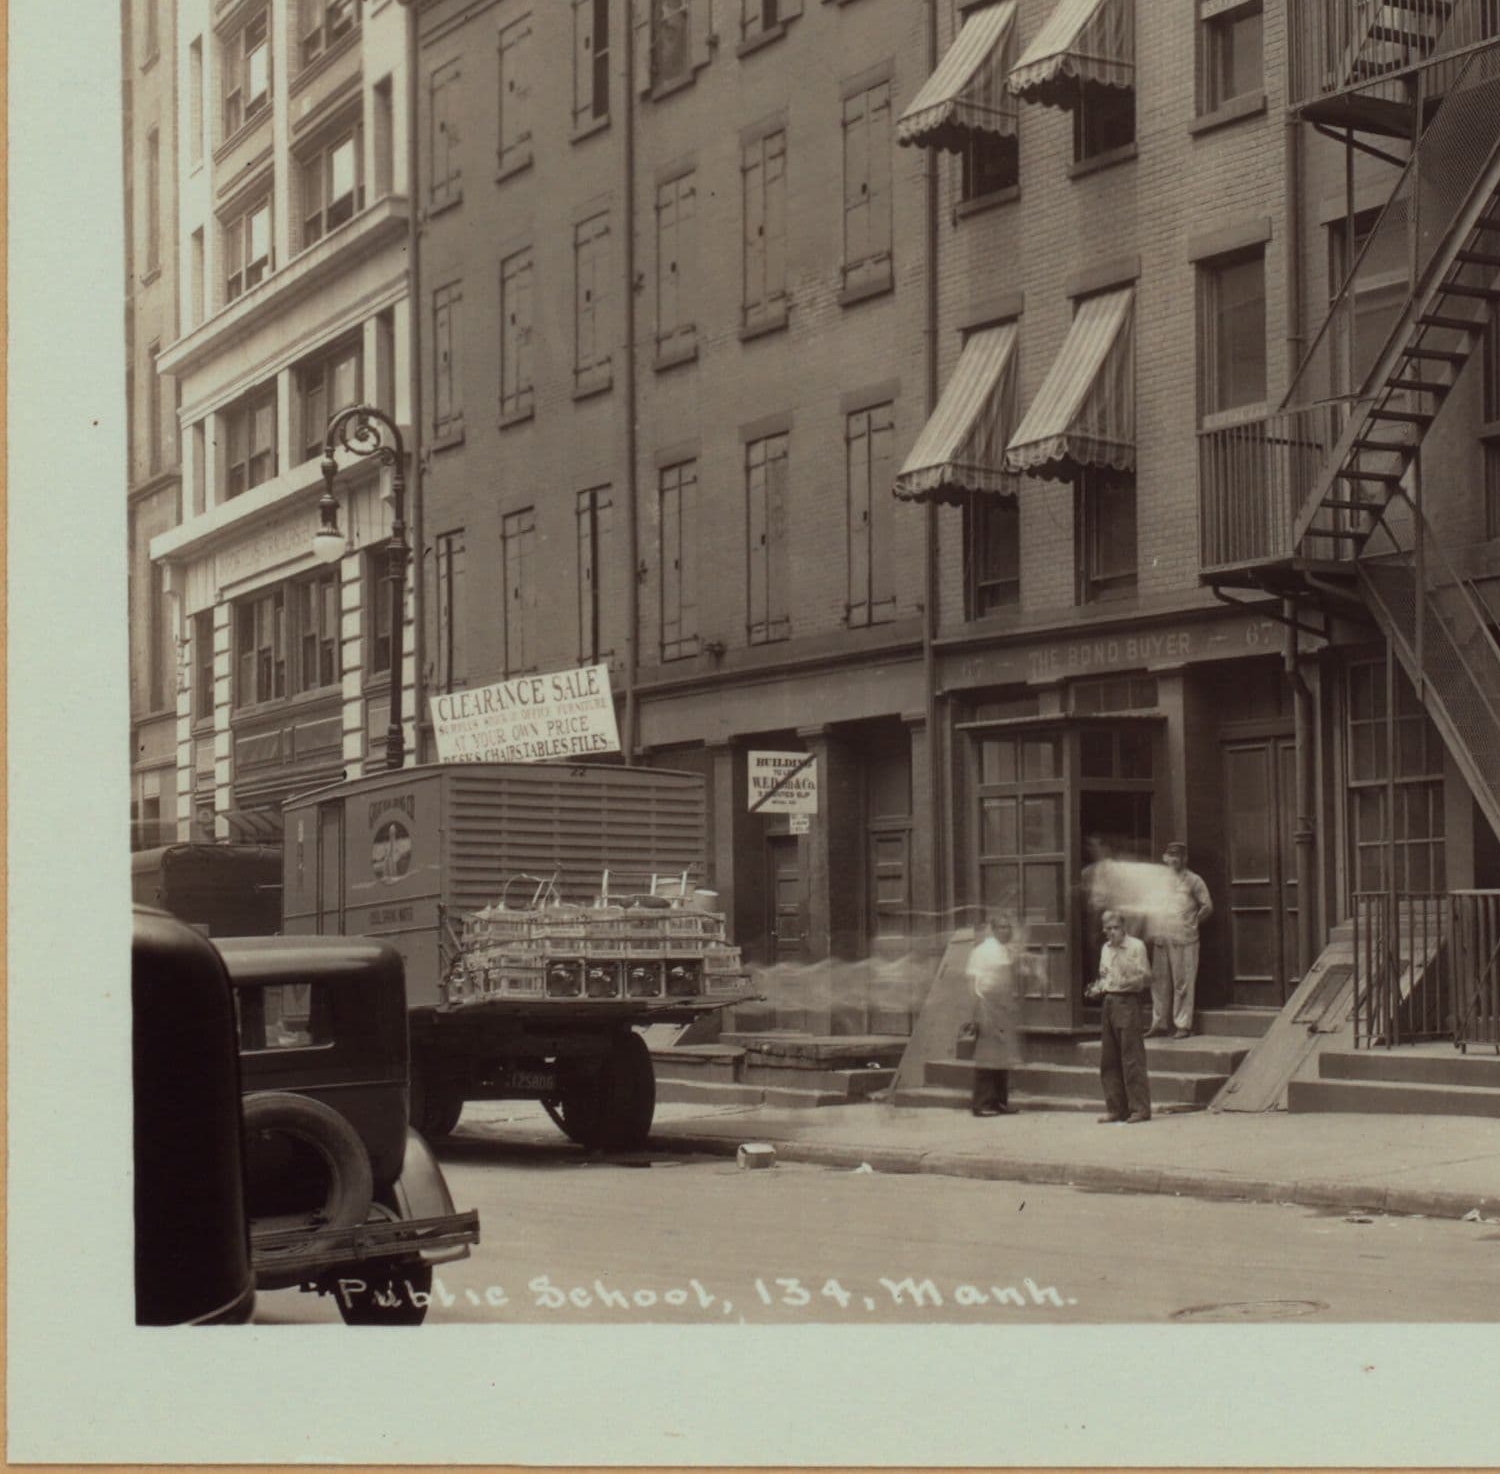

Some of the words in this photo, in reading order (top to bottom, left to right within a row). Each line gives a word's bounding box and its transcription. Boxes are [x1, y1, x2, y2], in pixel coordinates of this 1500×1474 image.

[1028, 650, 1058, 679] THE
[1067, 642, 1119, 667] BOND
[1126, 632, 1192, 661] BUYER
[438, 678, 545, 722] CLEARANCE
[551, 669, 600, 703] SALE
[472, 728, 507, 749] YOUR
[512, 722, 538, 741] OWN
[546, 715, 589, 737] PRICE
